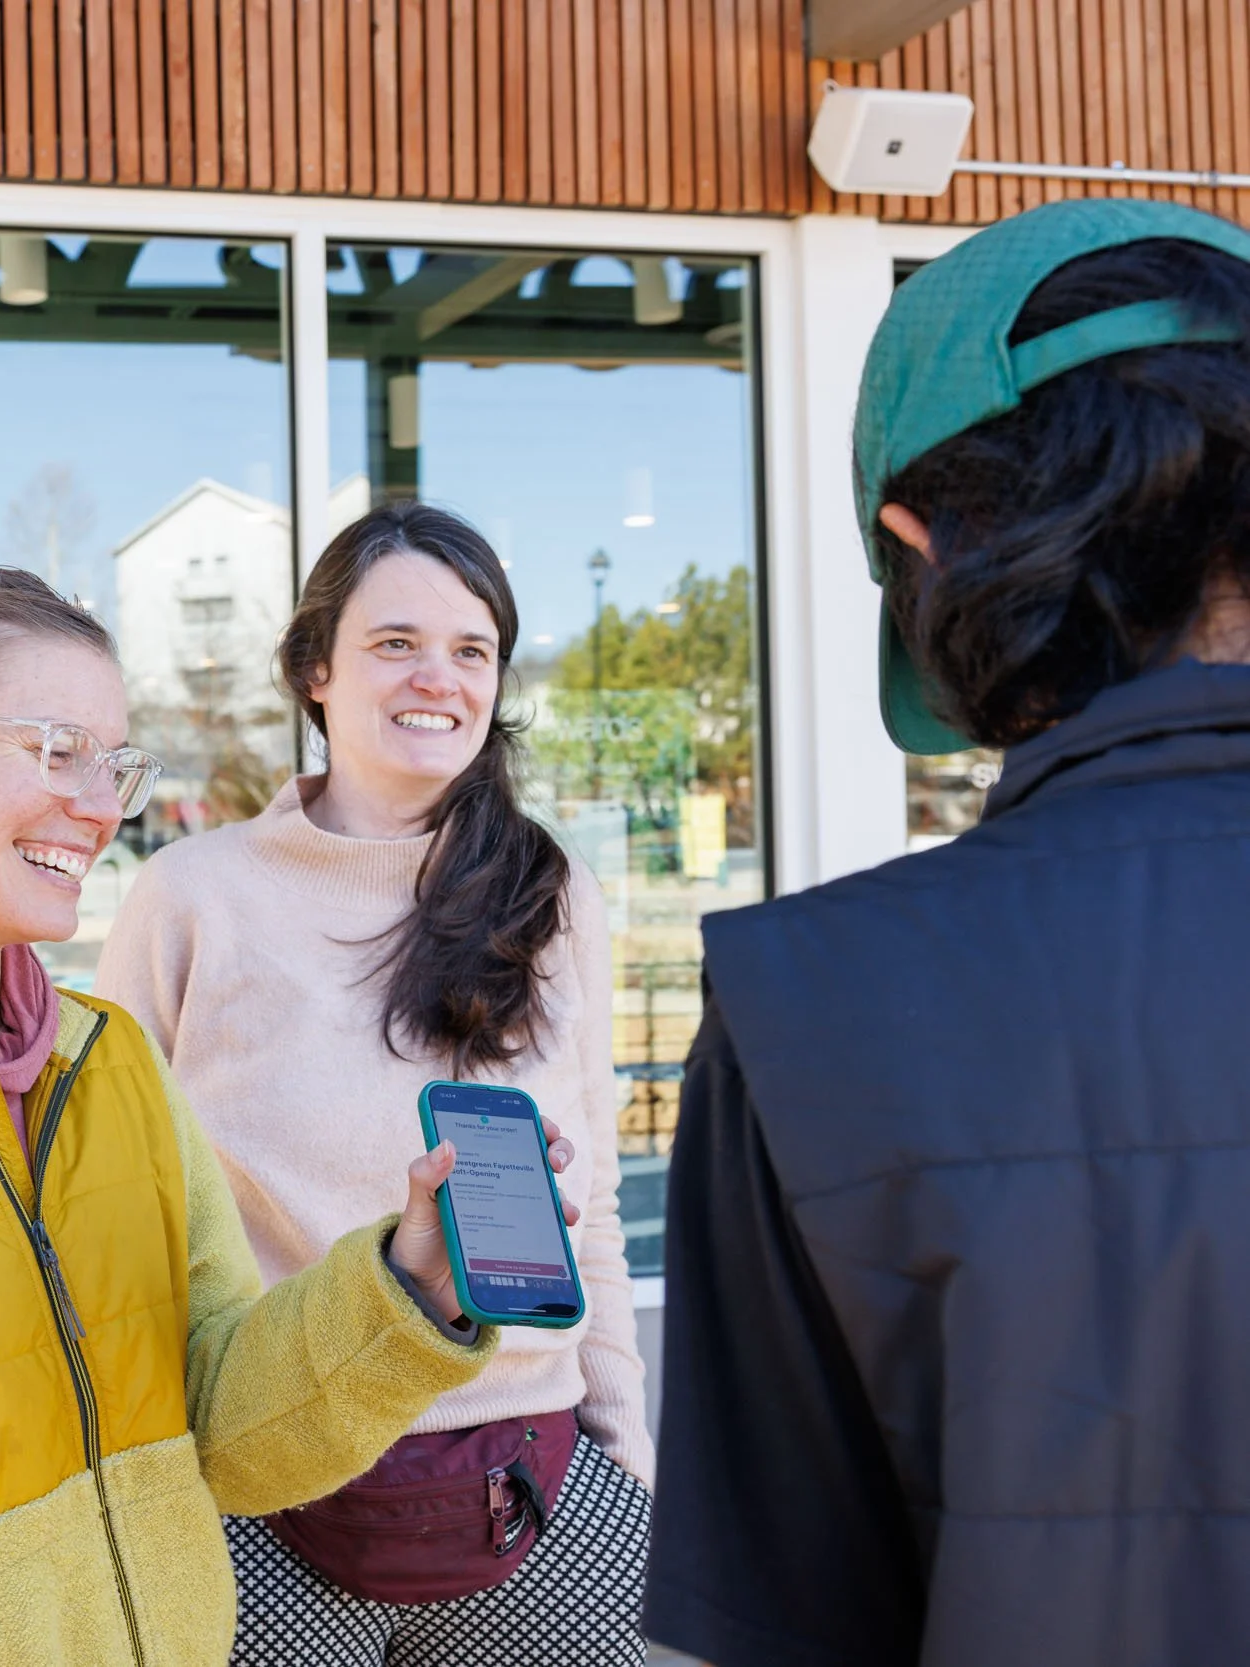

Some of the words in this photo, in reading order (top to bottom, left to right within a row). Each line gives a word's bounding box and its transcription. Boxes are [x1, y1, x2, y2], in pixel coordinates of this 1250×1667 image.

[454, 1122, 476, 1130] Thanks
[486, 1125, 499, 1133] your
[454, 1160, 492, 1169] weetgreen
[493, 1162, 534, 1172] Fayetteville
